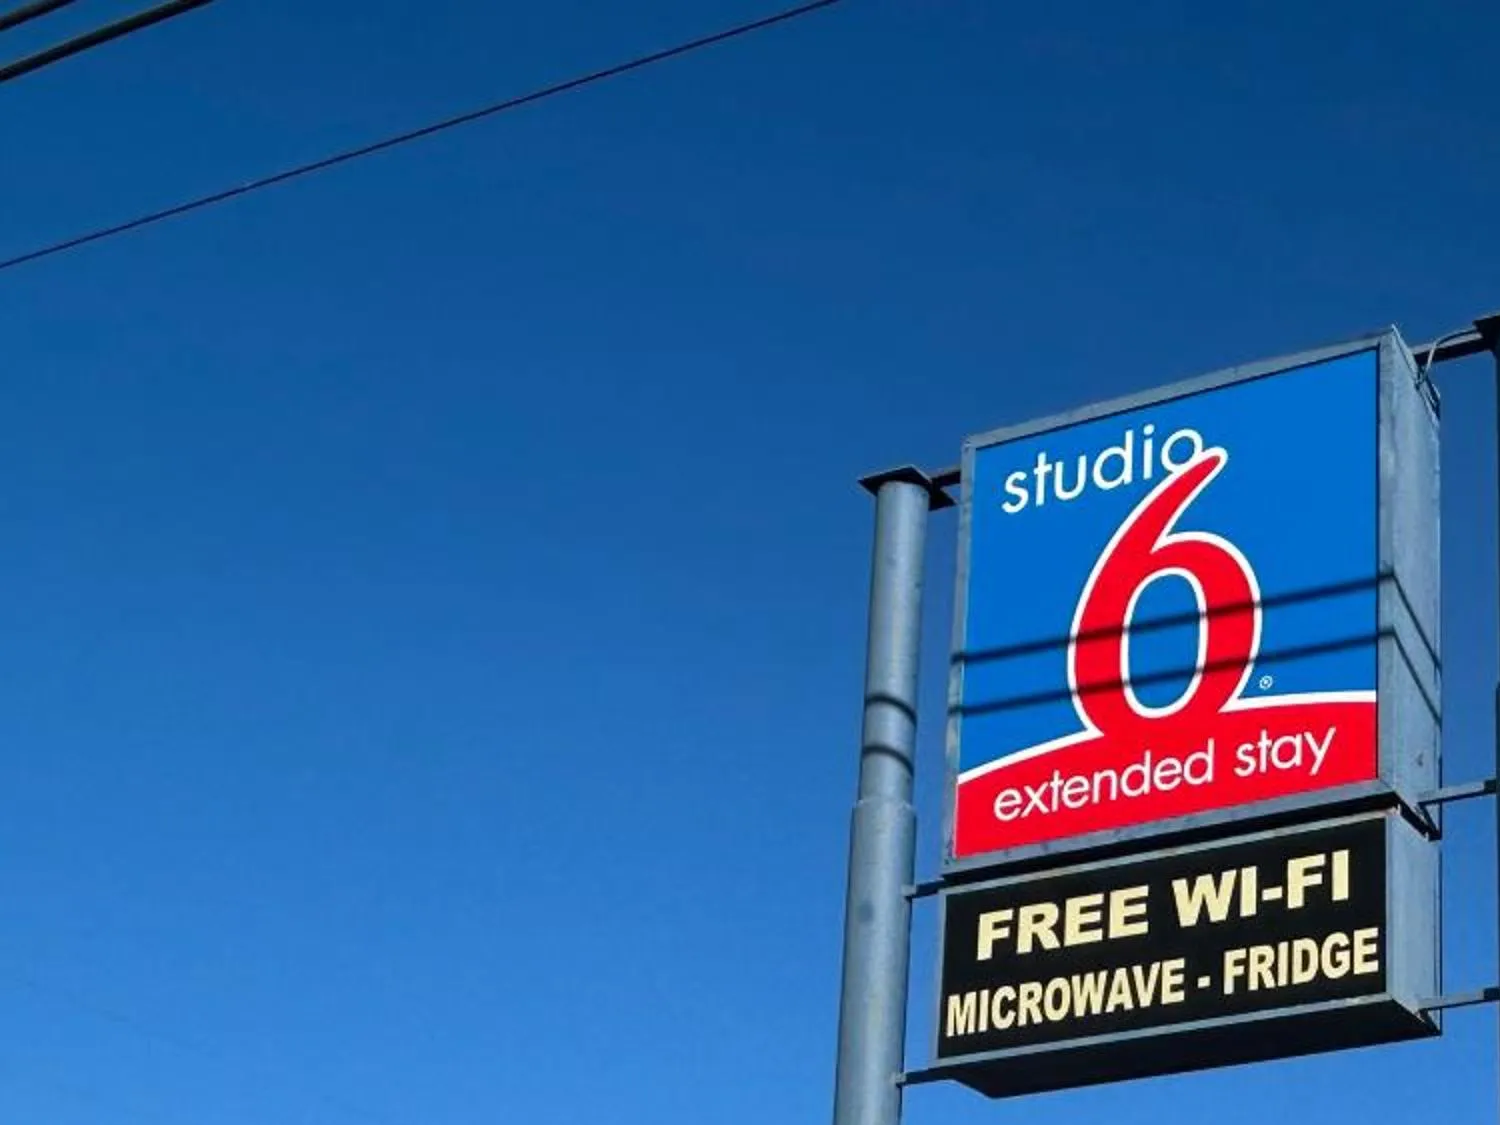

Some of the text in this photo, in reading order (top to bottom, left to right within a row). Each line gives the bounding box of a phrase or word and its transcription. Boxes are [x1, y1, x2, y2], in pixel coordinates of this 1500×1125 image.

[1002, 424, 1202, 512] studio
[1067, 446, 1263, 735] 6
[993, 727, 1336, 822] extended stay
[976, 849, 1351, 962] FREE WI-FI
[946, 927, 1380, 1038] MICROWAVE - FRIDGE
